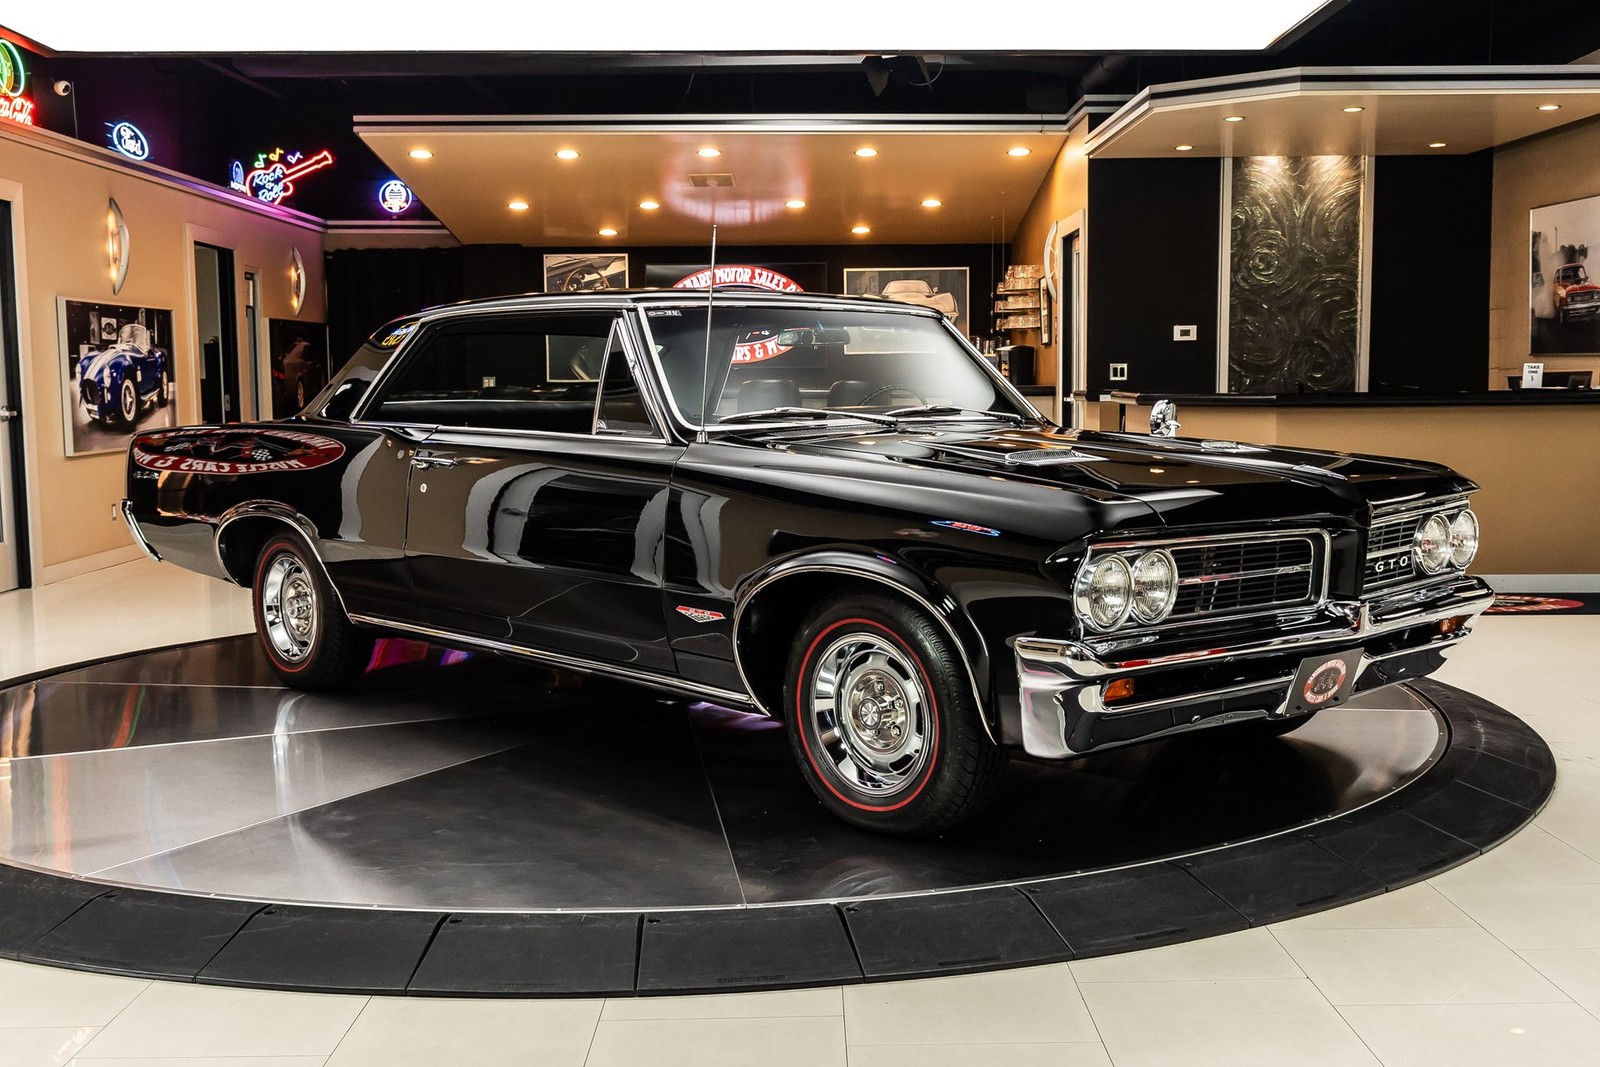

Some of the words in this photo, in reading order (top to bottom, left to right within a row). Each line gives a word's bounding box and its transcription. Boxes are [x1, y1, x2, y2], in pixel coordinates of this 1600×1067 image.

[252, 166, 284, 188] Rock
[258, 182, 284, 202] Roll
[714, 267, 752, 283] MOTOR
[753, 343, 764, 359] &
[1375, 555, 1408, 573] GTO
